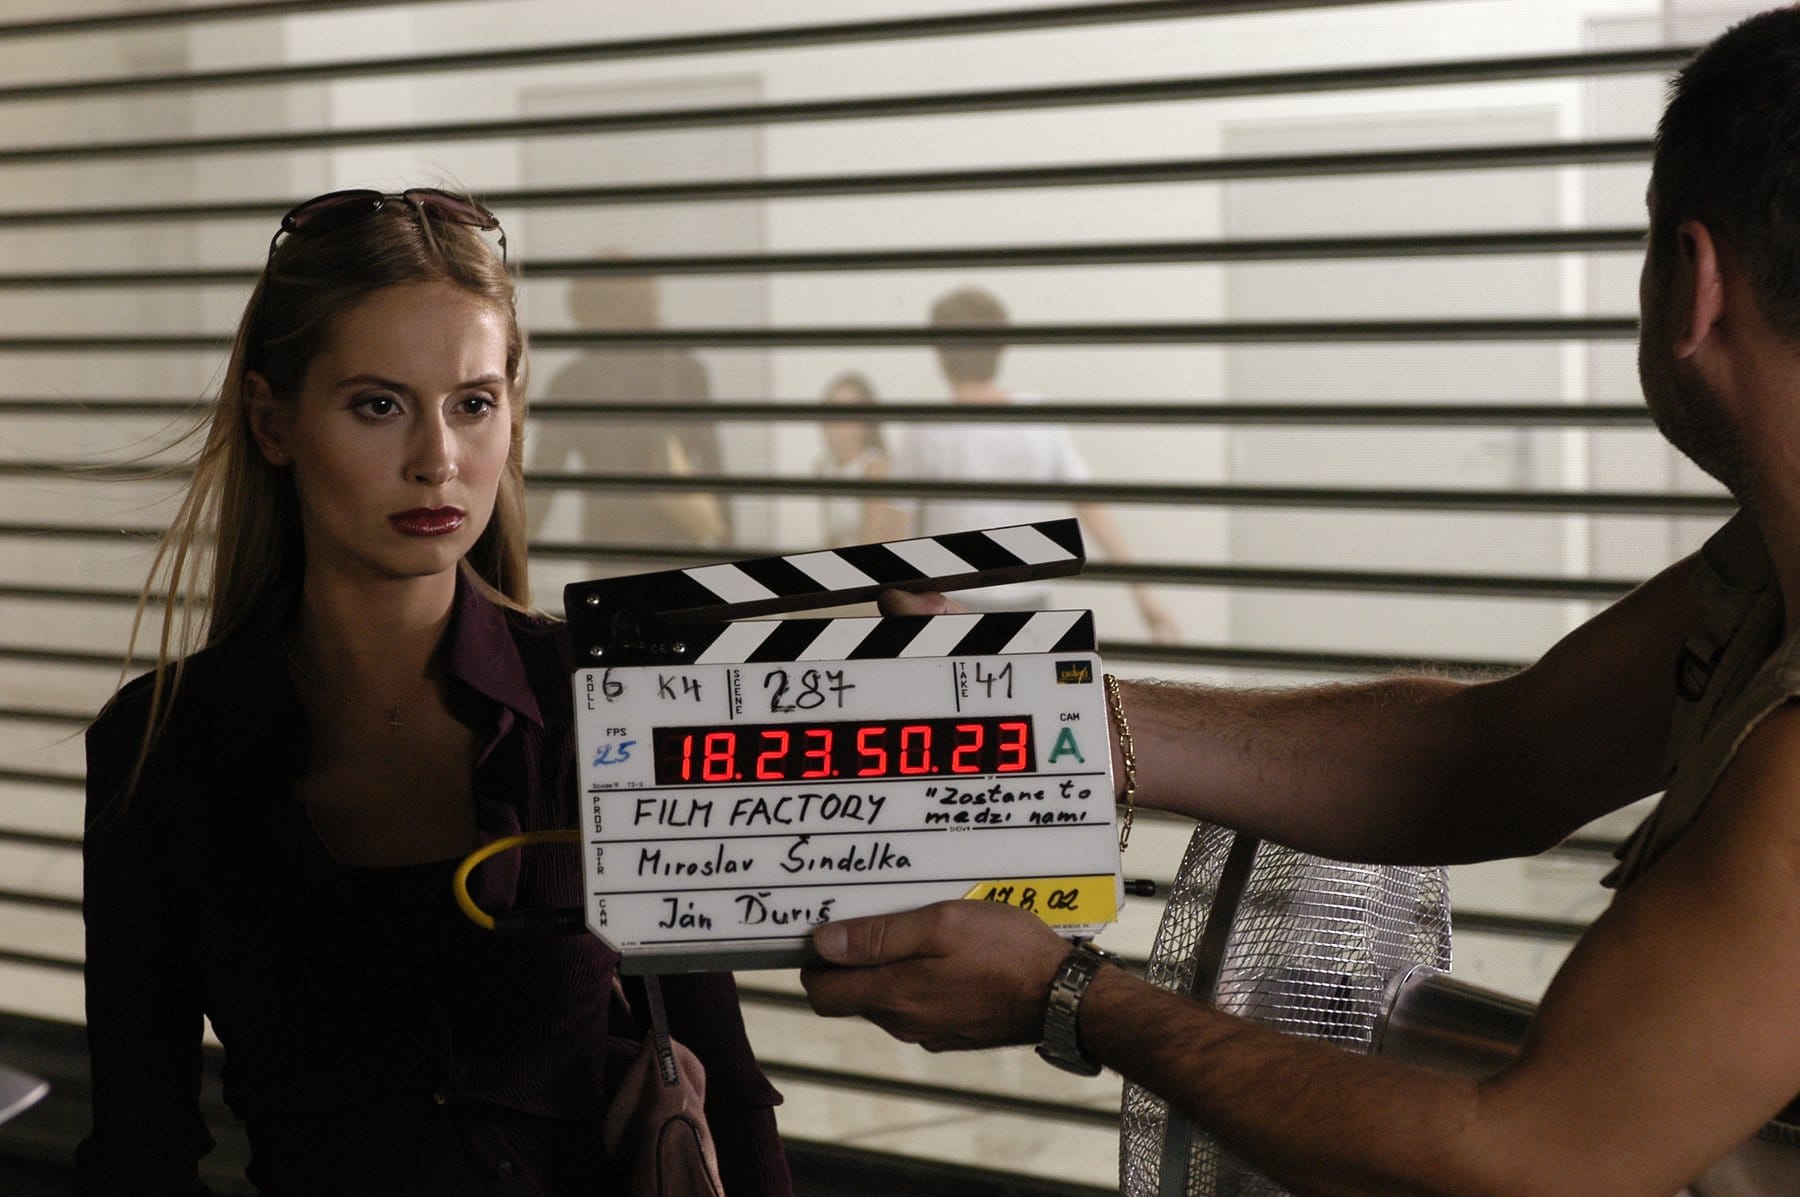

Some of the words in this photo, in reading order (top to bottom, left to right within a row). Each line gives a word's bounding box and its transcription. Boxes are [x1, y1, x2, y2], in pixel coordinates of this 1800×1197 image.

[585, 673, 596, 711] ROLL
[733, 669, 743, 715] SCENE
[763, 668, 856, 714] 287
[959, 661, 969, 698] TAKE
[975, 661, 1013, 698] 41
[606, 727, 628, 737] FPS
[1059, 712, 1081, 722] CAM
[592, 739, 637, 768] 25
[1047, 726, 1086, 764] A
[1059, 779, 1092, 801] to
[592, 796, 603, 834] PROD
[633, 797, 714, 829] FILM
[729, 793, 887, 826] FACTORY
[596, 847, 605, 875] DIR
[637, 843, 754, 877] Miroslav
[779, 834, 912, 874] Šindelka
[598, 899, 608, 927] CAM
[658, 897, 713, 931] Ján
